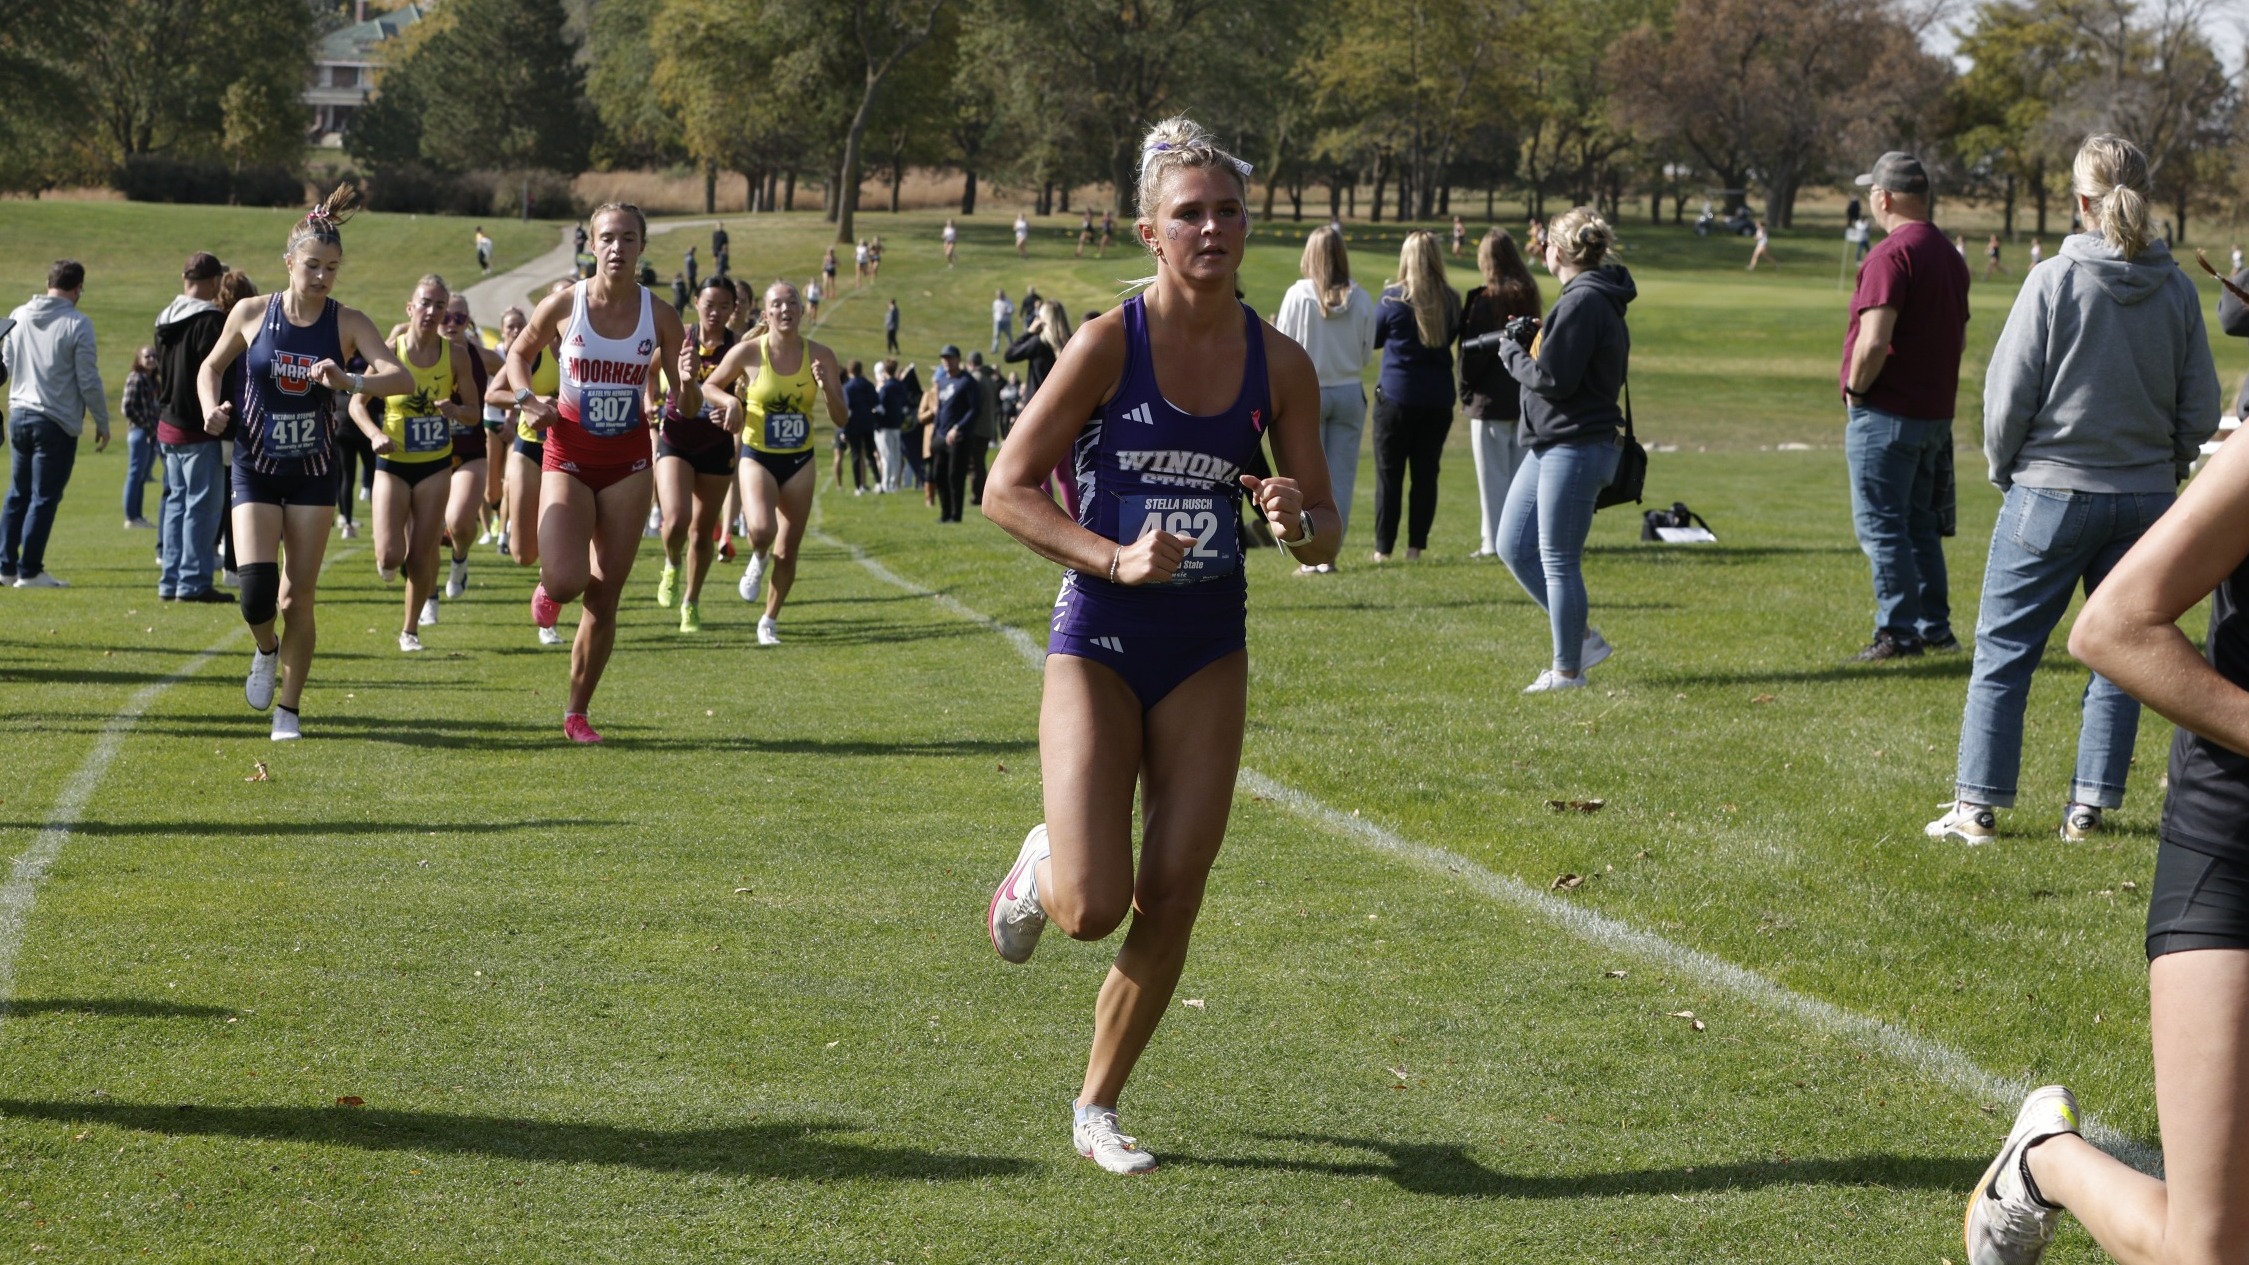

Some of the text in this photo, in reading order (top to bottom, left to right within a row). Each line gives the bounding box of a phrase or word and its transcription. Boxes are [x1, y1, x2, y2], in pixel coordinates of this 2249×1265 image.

[273, 361, 312, 381] MAR
[568, 356, 649, 386] MOORHEAD
[589, 397, 632, 422] 307
[272, 419, 316, 444] 412
[411, 421, 444, 441] 112
[771, 420, 804, 438] 120
[1144, 498, 1213, 510] STELLA RUSCH
[1183, 560, 1204, 569] State
